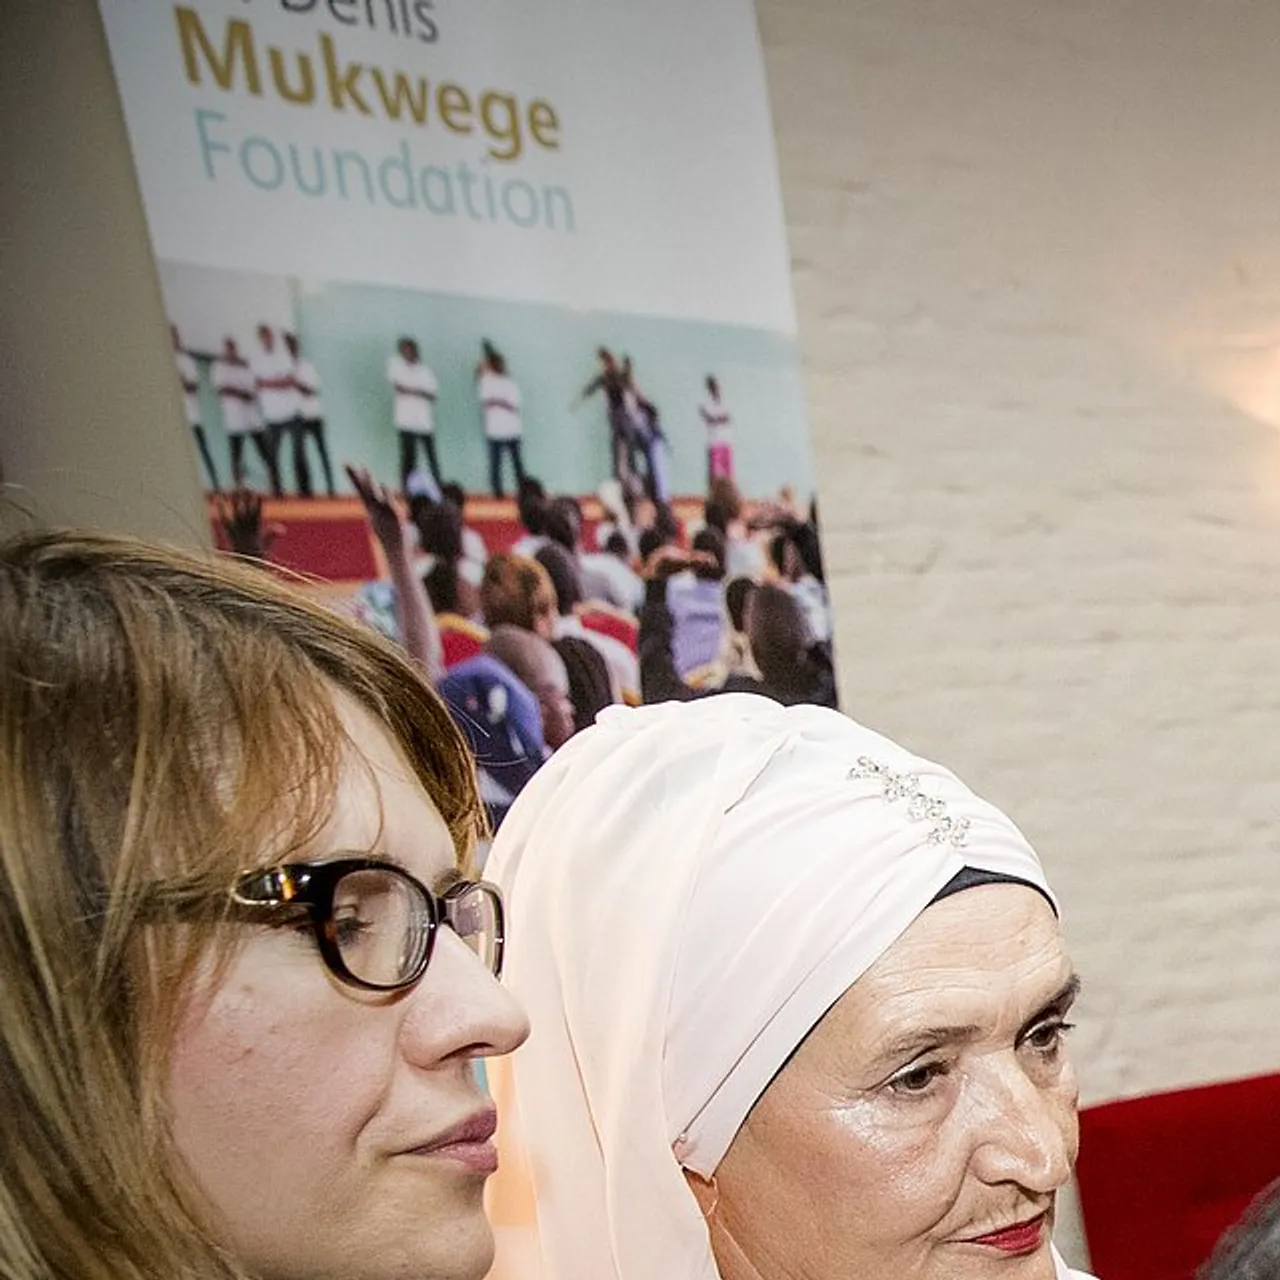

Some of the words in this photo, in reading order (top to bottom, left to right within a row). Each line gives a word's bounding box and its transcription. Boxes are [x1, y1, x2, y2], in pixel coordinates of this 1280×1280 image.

[173, 4, 563, 163] Mukwege
[280, 0, 439, 43] enis
[193, 108, 577, 234] Foundation
